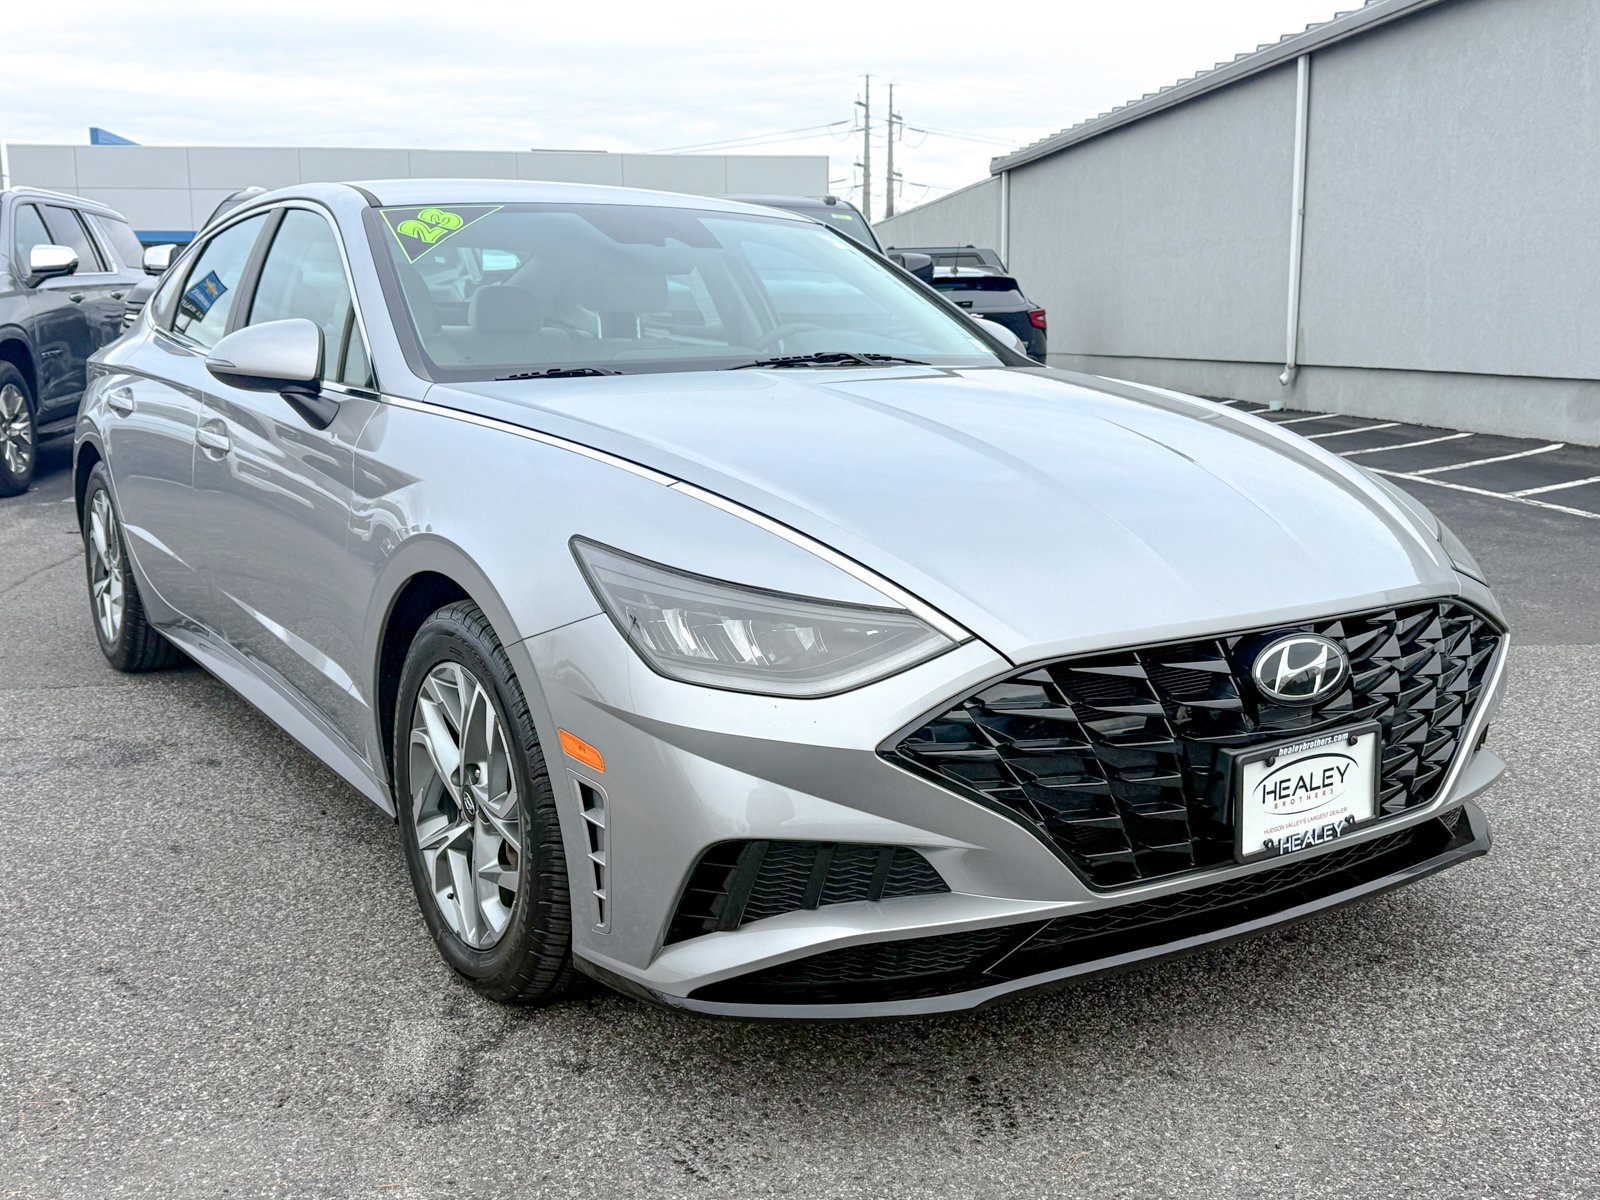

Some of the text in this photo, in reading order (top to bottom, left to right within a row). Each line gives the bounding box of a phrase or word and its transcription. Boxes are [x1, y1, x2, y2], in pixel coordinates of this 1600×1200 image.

[397, 208, 464, 244] 23
[1278, 732, 1349, 757] healeybrothers.com
[1262, 762, 1350, 805] HEALEY
[1274, 788, 1334, 810] BROTHERS
[1263, 824, 1285, 835] HUDSON
[1307, 811, 1329, 824] LARGEST
[1329, 806, 1348, 817] DEALER
[1278, 820, 1344, 855] HEALEY
